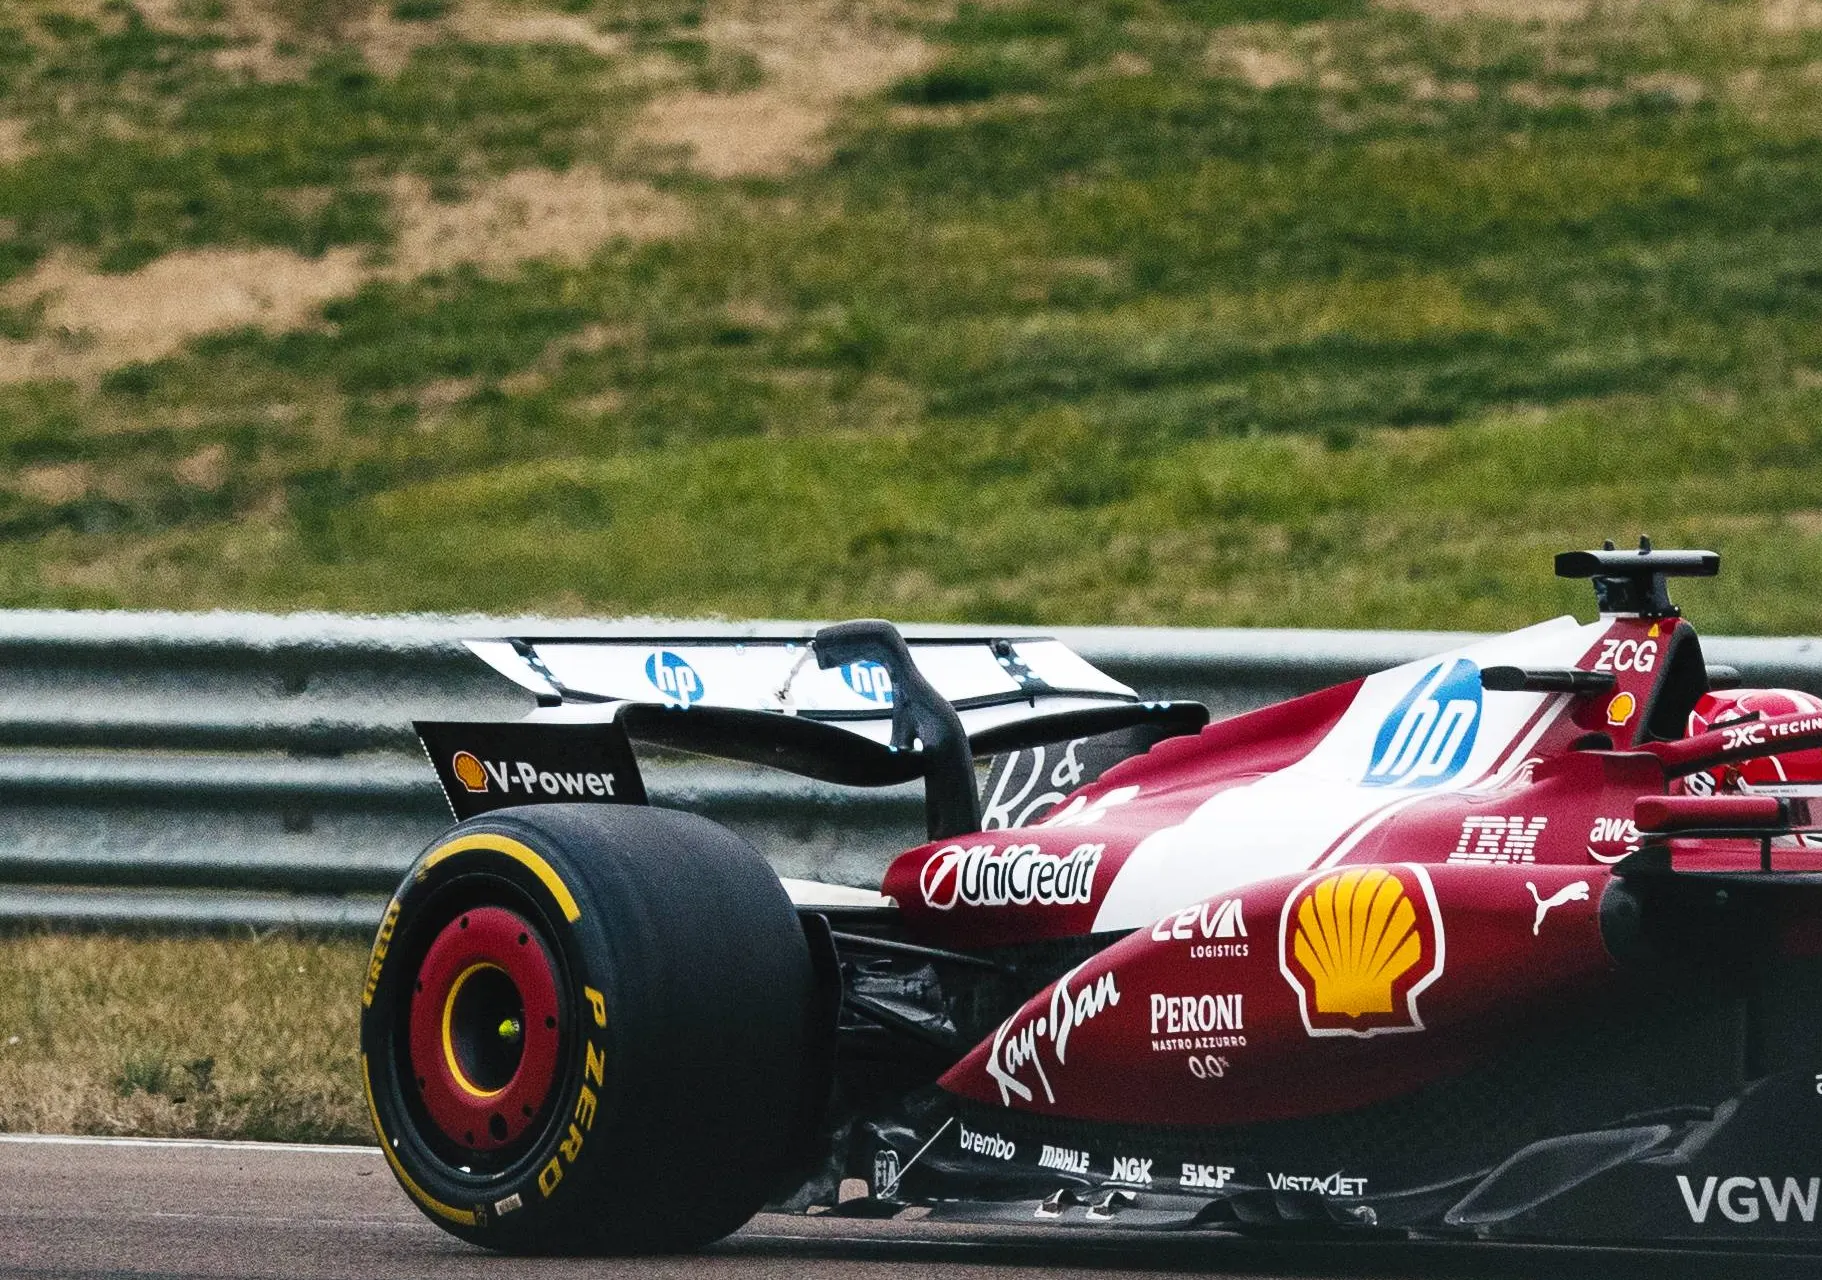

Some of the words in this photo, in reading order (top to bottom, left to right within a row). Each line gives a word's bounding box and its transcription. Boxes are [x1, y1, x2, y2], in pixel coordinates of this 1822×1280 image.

[1595, 639, 1657, 672] ZCG
[646, 651, 704, 708] hp
[488, 760, 615, 797] V-Power
[1446, 816, 1548, 864] IBM
[961, 850, 1098, 901] UniCredit
[1190, 944, 1249, 958] LOGISTICS
[584, 985, 608, 1028] P
[1150, 994, 1244, 1034] PERONI
[1152, 1039, 1193, 1051] NASTRO
[1195, 1036, 1248, 1049] AZZURRO
[536, 1039, 606, 1198] ZERO
[960, 1123, 1016, 1161] brembo
[1038, 1145, 1091, 1174] MAHLE
[1110, 1157, 1153, 1184] NGK
[1180, 1163, 1236, 1189] SKF
[1675, 1175, 1821, 1224] VGW
